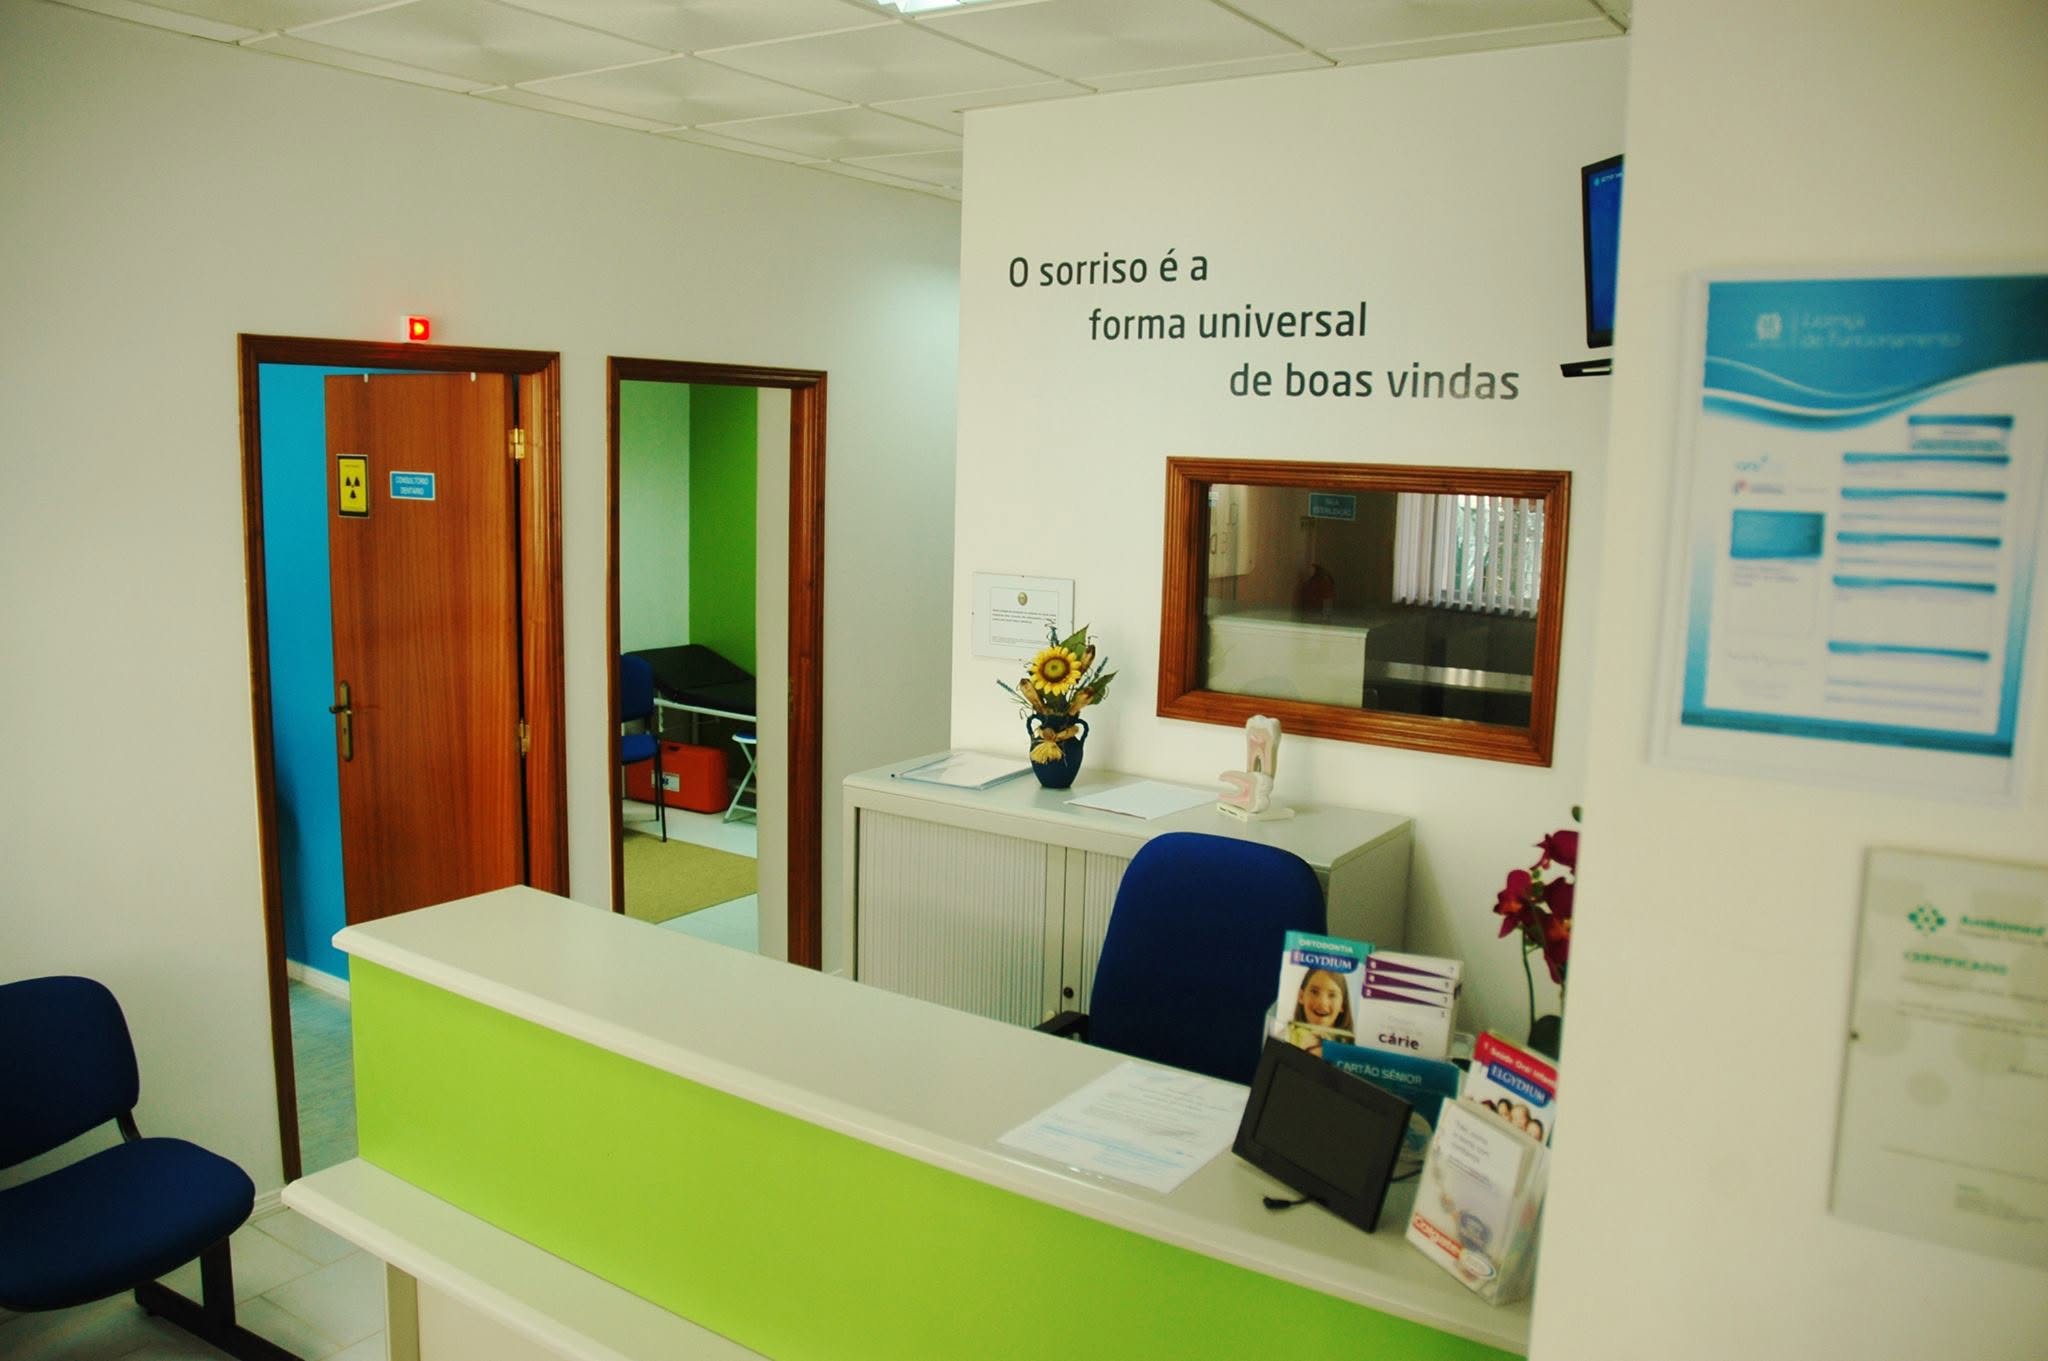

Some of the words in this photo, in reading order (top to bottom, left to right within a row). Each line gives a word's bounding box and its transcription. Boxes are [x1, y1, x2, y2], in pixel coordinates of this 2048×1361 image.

[1009, 256, 1029, 287] O
[1039, 251, 1148, 287] sorriso
[1160, 247, 1178, 283] é
[1190, 255, 1208, 282] a
[1088, 308, 1185, 341] forma
[1199, 301, 1367, 339] universal
[1229, 362, 1273, 397] de
[1285, 362, 1374, 398] boas
[1386, 361, 1520, 401] vindas
[1293, 951, 1353, 971] ELGYDIUM
[1377, 1032, 1420, 1051] cárie
[1490, 1062, 1547, 1106] ELGYDIUM
